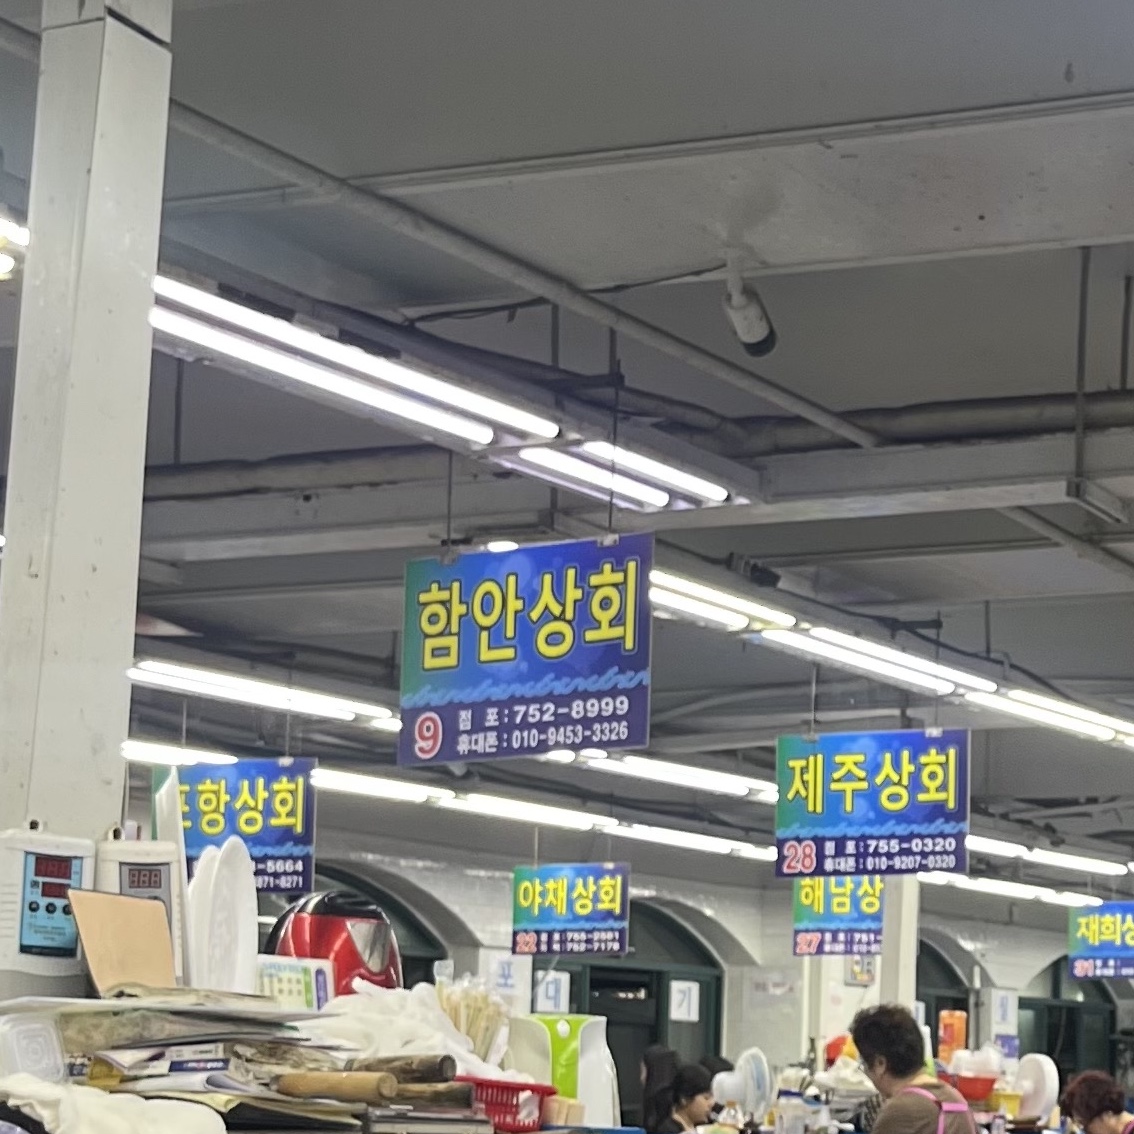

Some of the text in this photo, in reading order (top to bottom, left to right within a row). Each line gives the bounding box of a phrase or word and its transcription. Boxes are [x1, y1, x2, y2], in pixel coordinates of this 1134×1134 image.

[418, 560, 637, 671] 함안상회
[513, 696, 630, 724] 752-8999
[414, 711, 443, 760] 9
[457, 732, 499, 755] 휴대폰
[512, 721, 629, 749] 010-9453-3326
[787, 748, 957, 814] 제주상회
[782, 840, 817, 874] 28
[866, 837, 957, 855] 755-0320
[252, 858, 304, 874] -5664
[518, 874, 622, 917] 야채상회
[515, 931, 538, 954] 22
[796, 932, 822, 954] 27
